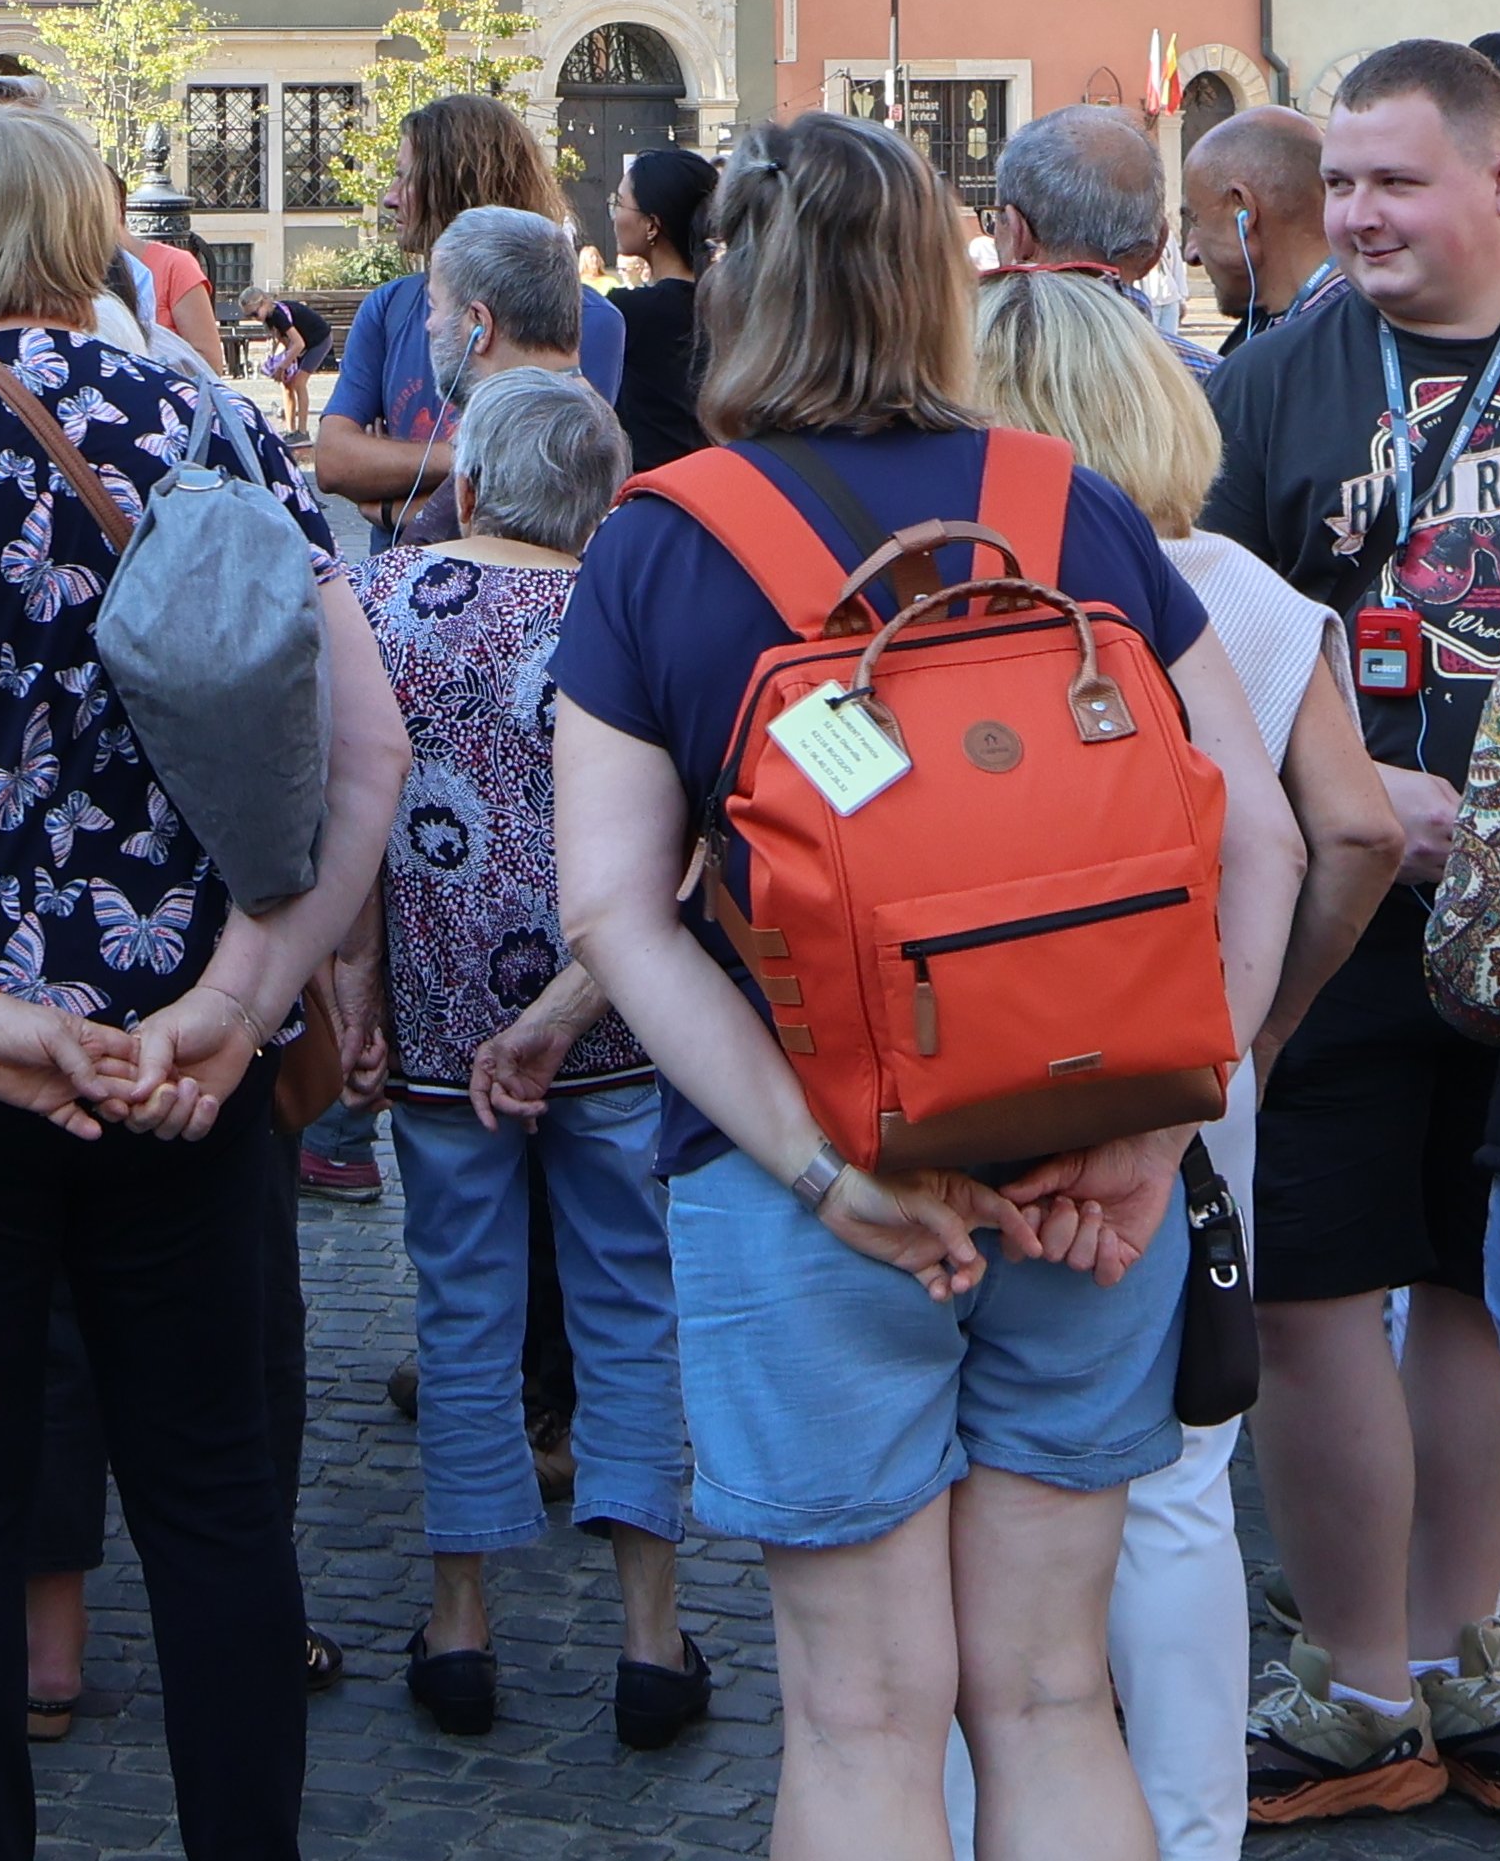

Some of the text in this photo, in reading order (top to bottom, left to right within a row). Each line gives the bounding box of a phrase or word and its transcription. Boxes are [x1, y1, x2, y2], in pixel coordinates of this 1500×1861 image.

[1397, 437, 1408, 472] GUIDESET
[1449, 425, 1470, 459] GUIDESET
[1351, 470, 1456, 535] HD
